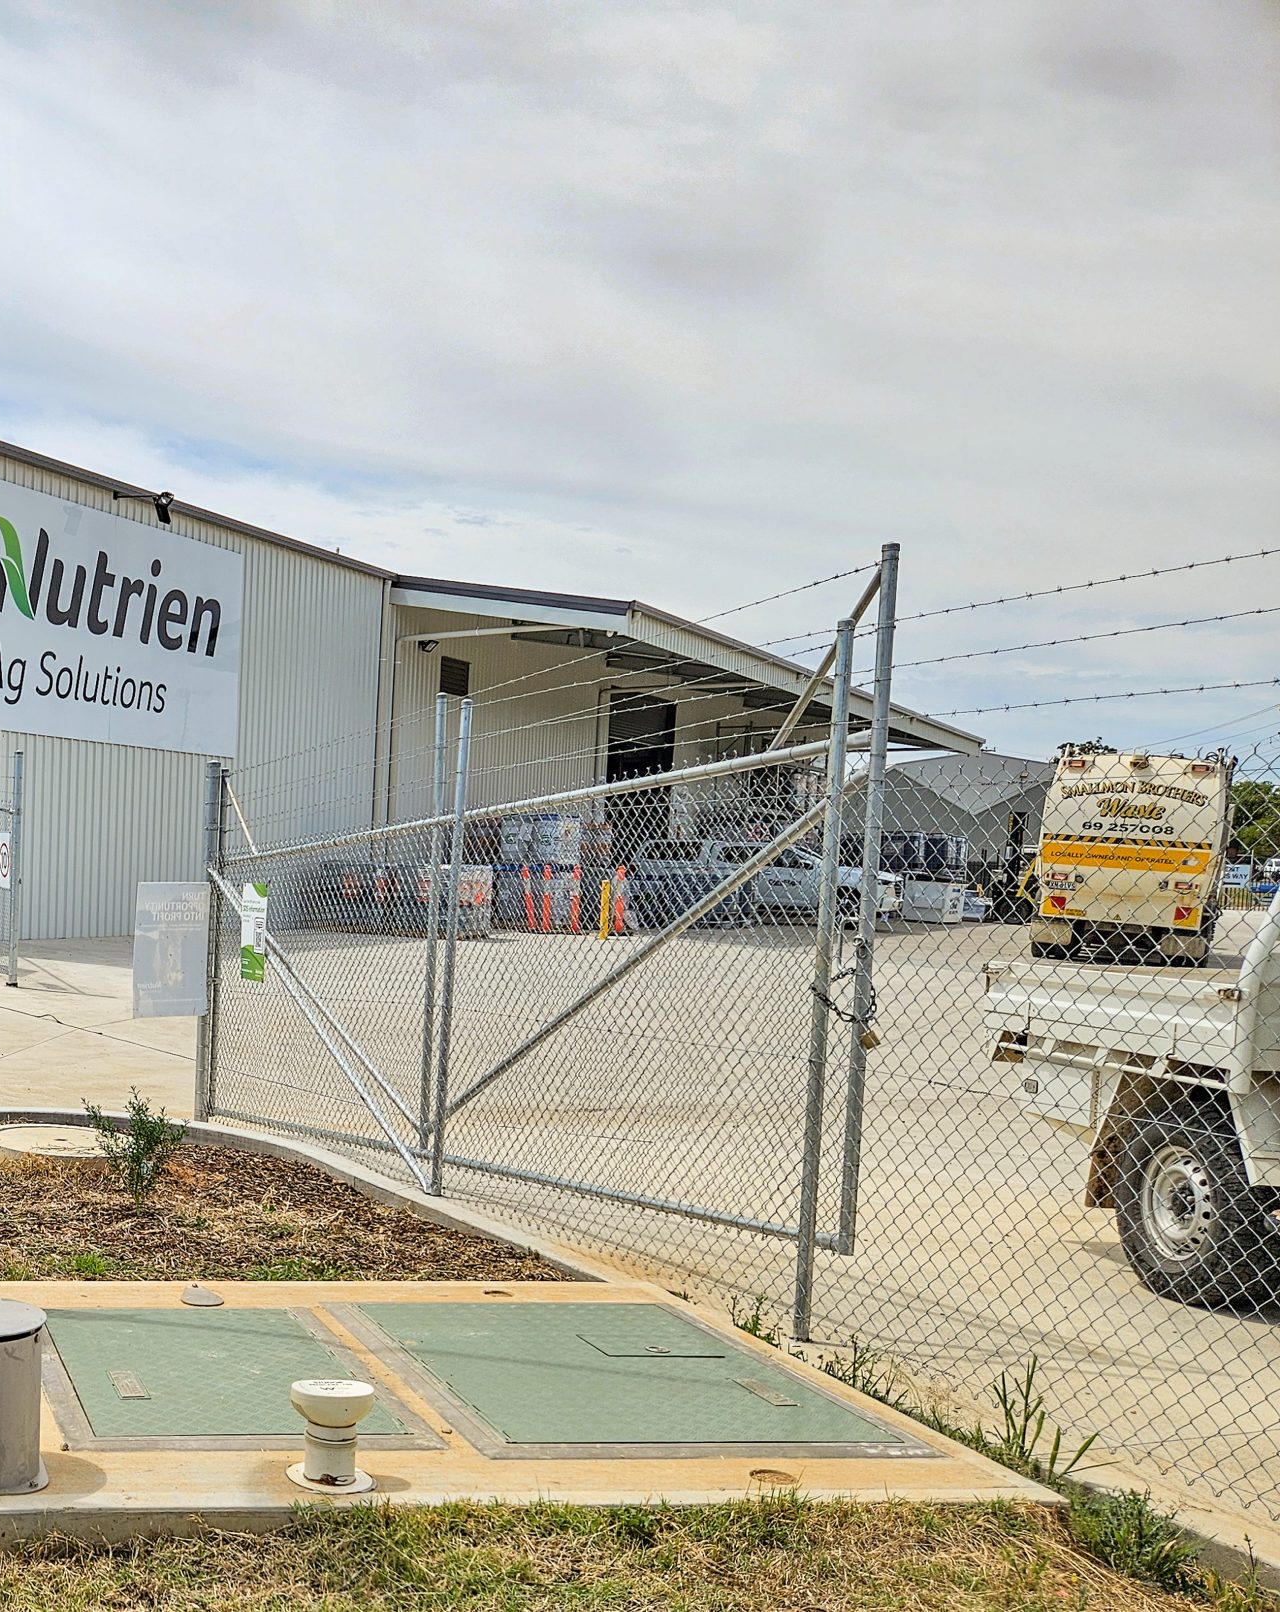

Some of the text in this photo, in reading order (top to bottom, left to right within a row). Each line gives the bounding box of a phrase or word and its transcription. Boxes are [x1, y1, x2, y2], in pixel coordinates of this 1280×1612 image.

[35, 651, 167, 713] Solutions
[1137, 780, 1209, 807] BROTHERS
[1096, 797, 1167, 820] Waste
[1082, 821, 1174, 835] 69 257008
